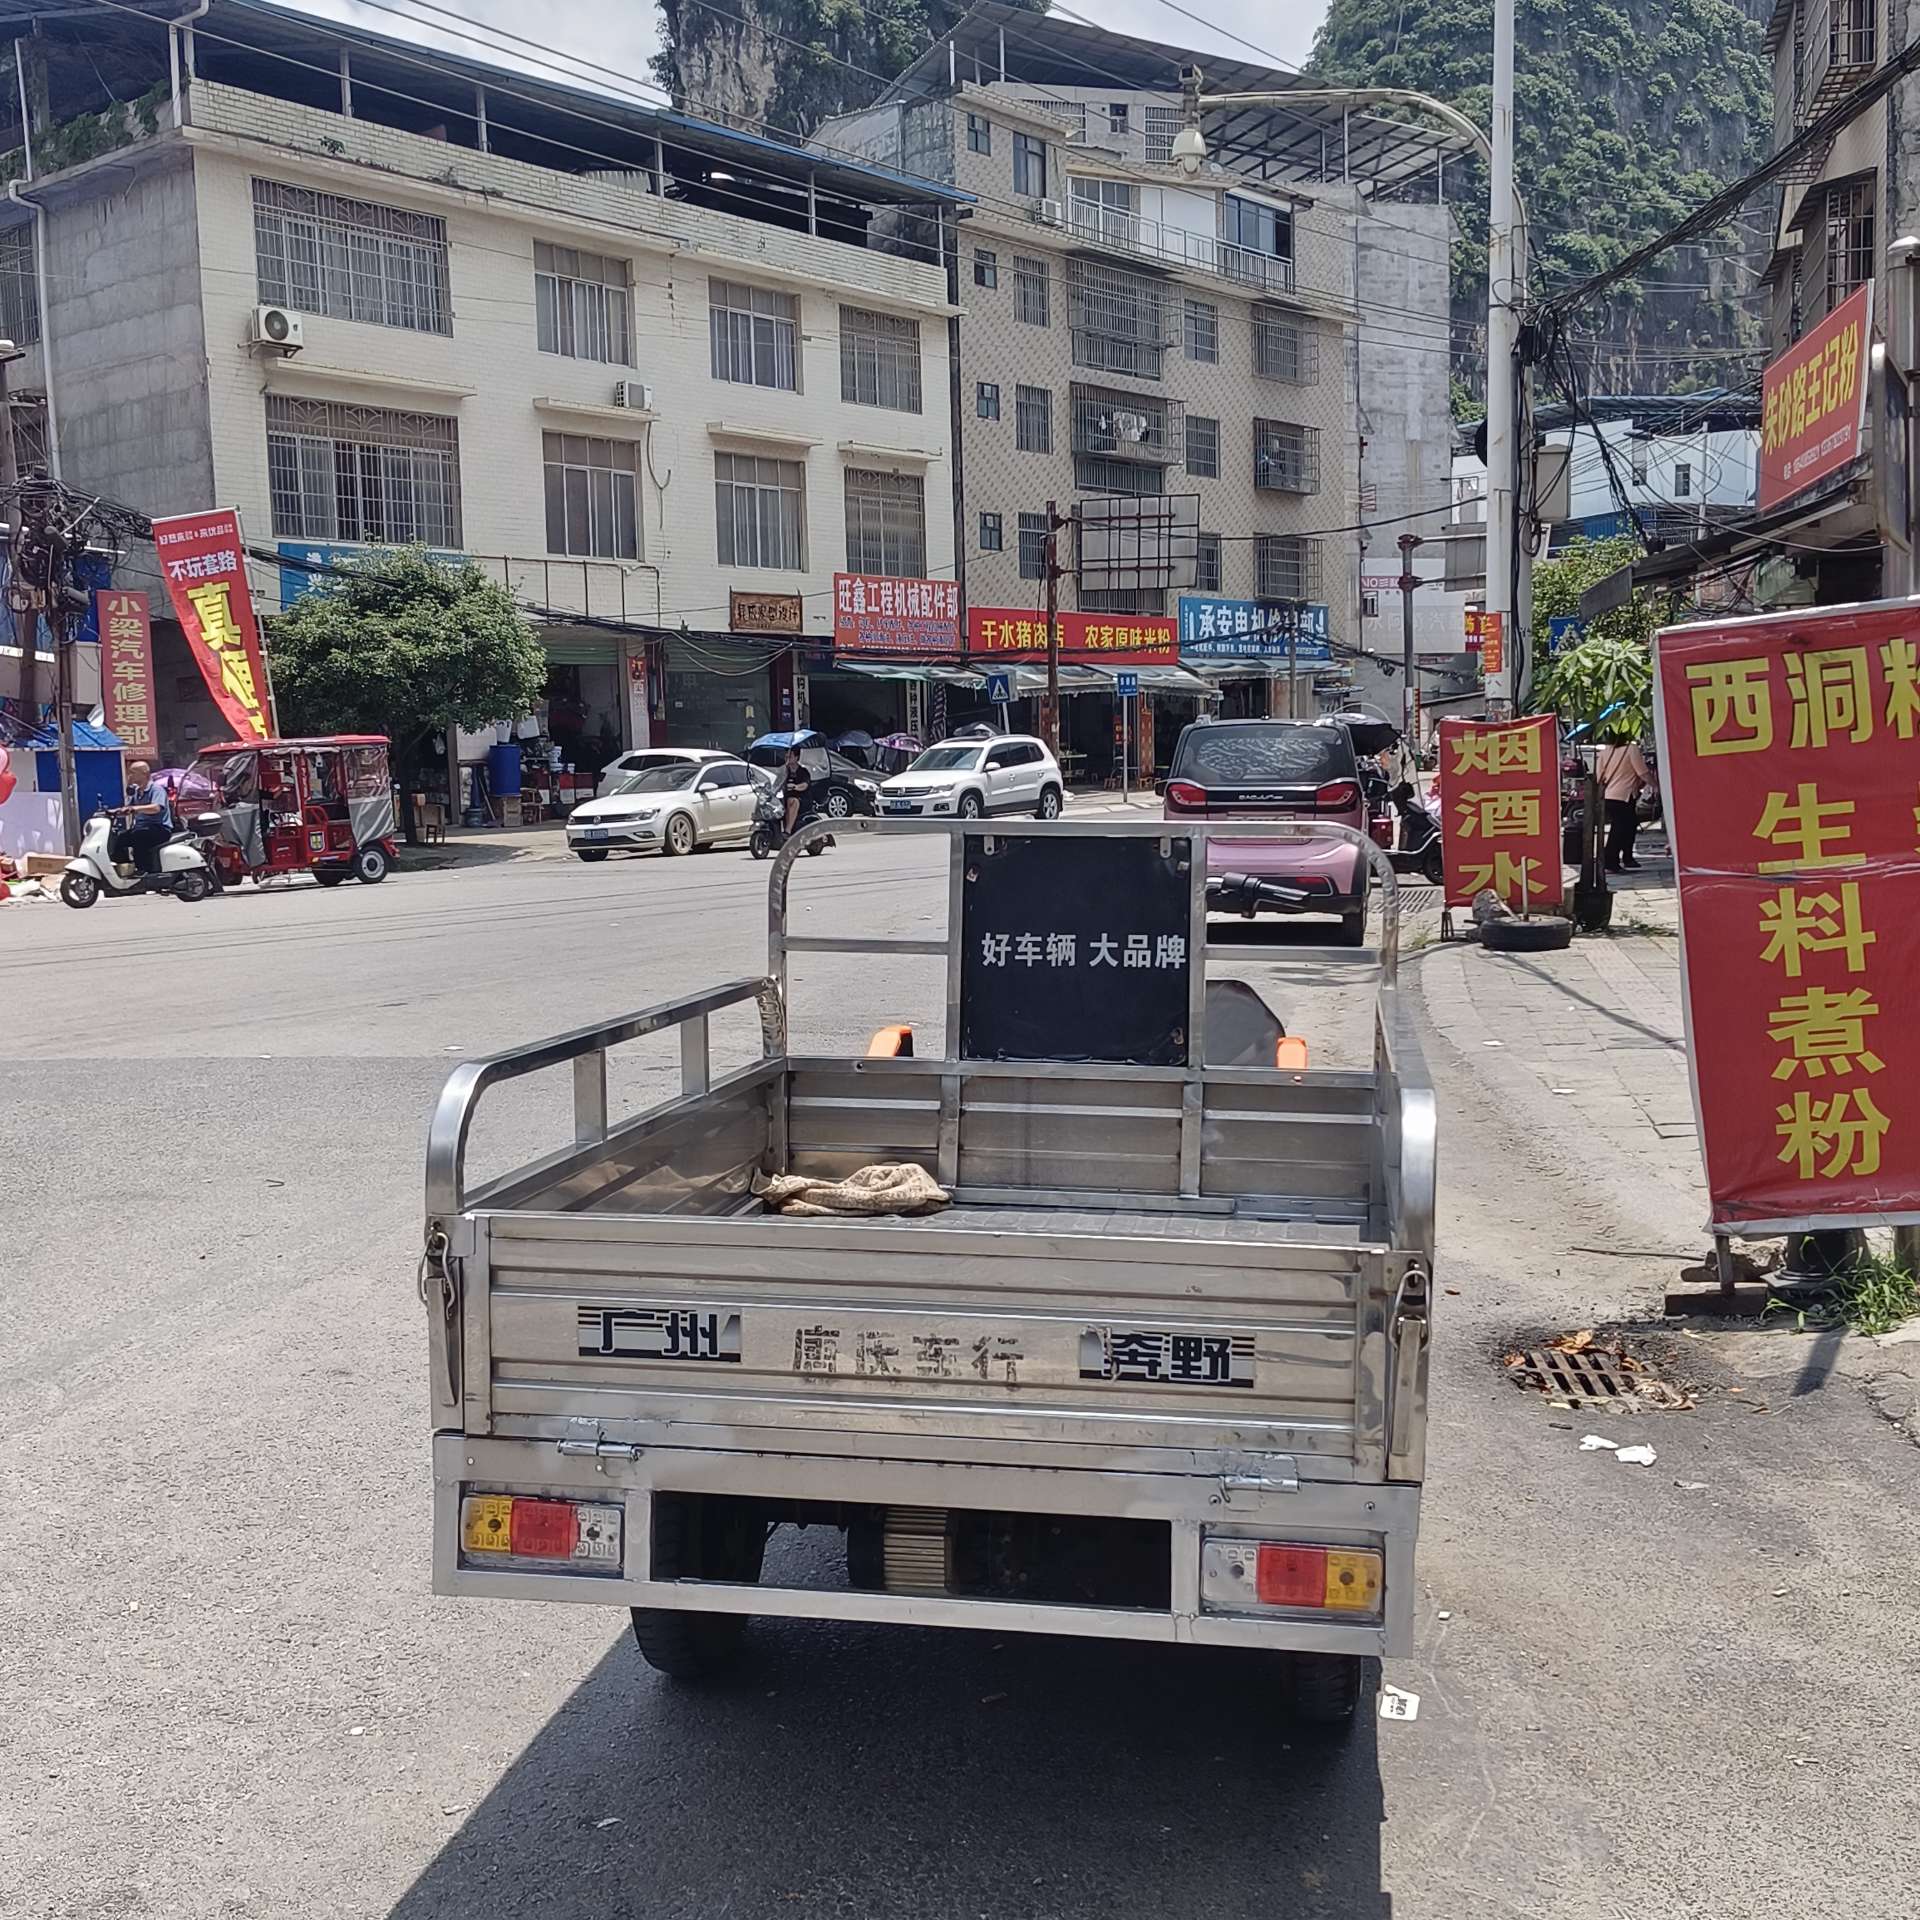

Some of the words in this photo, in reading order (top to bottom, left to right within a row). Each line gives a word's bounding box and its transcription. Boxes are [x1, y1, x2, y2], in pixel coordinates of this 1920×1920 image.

[168, 550, 237, 581] 不玩套路
[838, 577, 959, 621] 旺鑫工程机械配件部
[1085, 624, 1171, 654] 农家原味米粉
[107, 596, 150, 745] 小梁汽车修理部
[1451, 726, 1549, 899] 烟酒水
[981, 932, 1077, 967] 好车辆
[1089, 932, 1186, 969] 大品牌
[1752, 783, 1891, 1180] 生料煮粉
[600, 1309, 719, 1356] 广州
[1102, 1331, 1232, 1382] 奔野
